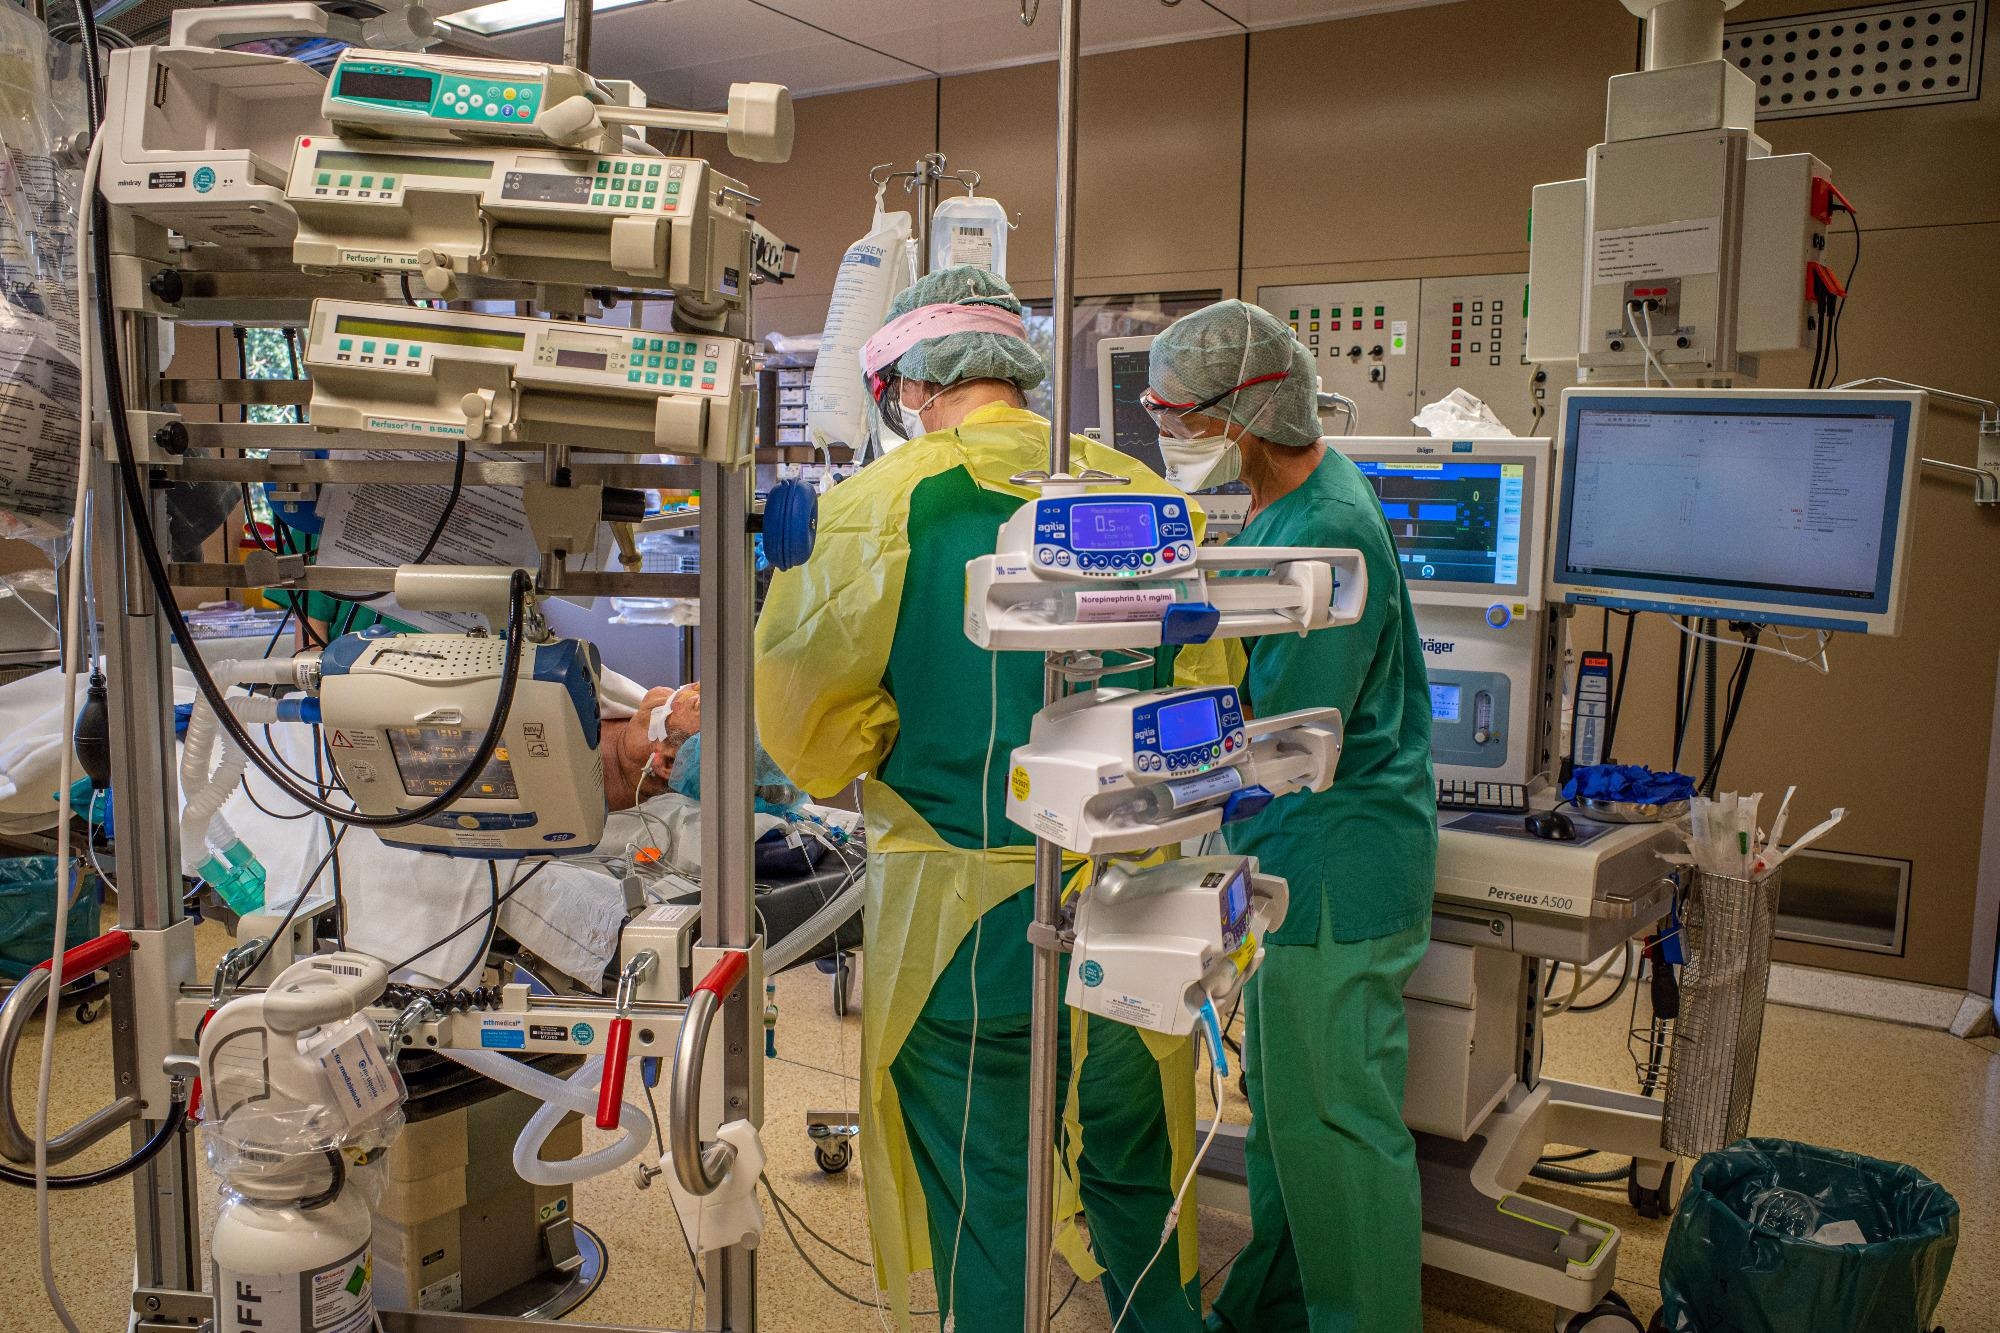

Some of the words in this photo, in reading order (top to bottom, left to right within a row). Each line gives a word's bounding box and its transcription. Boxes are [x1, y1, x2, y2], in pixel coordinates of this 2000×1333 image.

[635, 165, 641, 173] 9
[628, 198, 634, 206] 3
[383, 256, 393, 264] fm
[652, 341, 659, 349] 8
[669, 342, 676, 351] 9
[650, 357, 657, 365] 5
[667, 359, 674, 367] 6
[684, 360, 692, 368] C
[437, 426, 465, 435] BRAUN
[1473, 490, 1480, 501] 0
[1037, 522, 1066, 533] agilia
[1081, 595, 1135, 605] Norepinephrin
[1136, 594, 1147, 603] 0,1
[1148, 593, 1172, 603] mg/ml
[1134, 727, 1156, 742] agilia
[1487, 886, 1538, 905] Perseus
[1540, 895, 1573, 910] A500
[338, 1065, 362, 1109] medizinische
